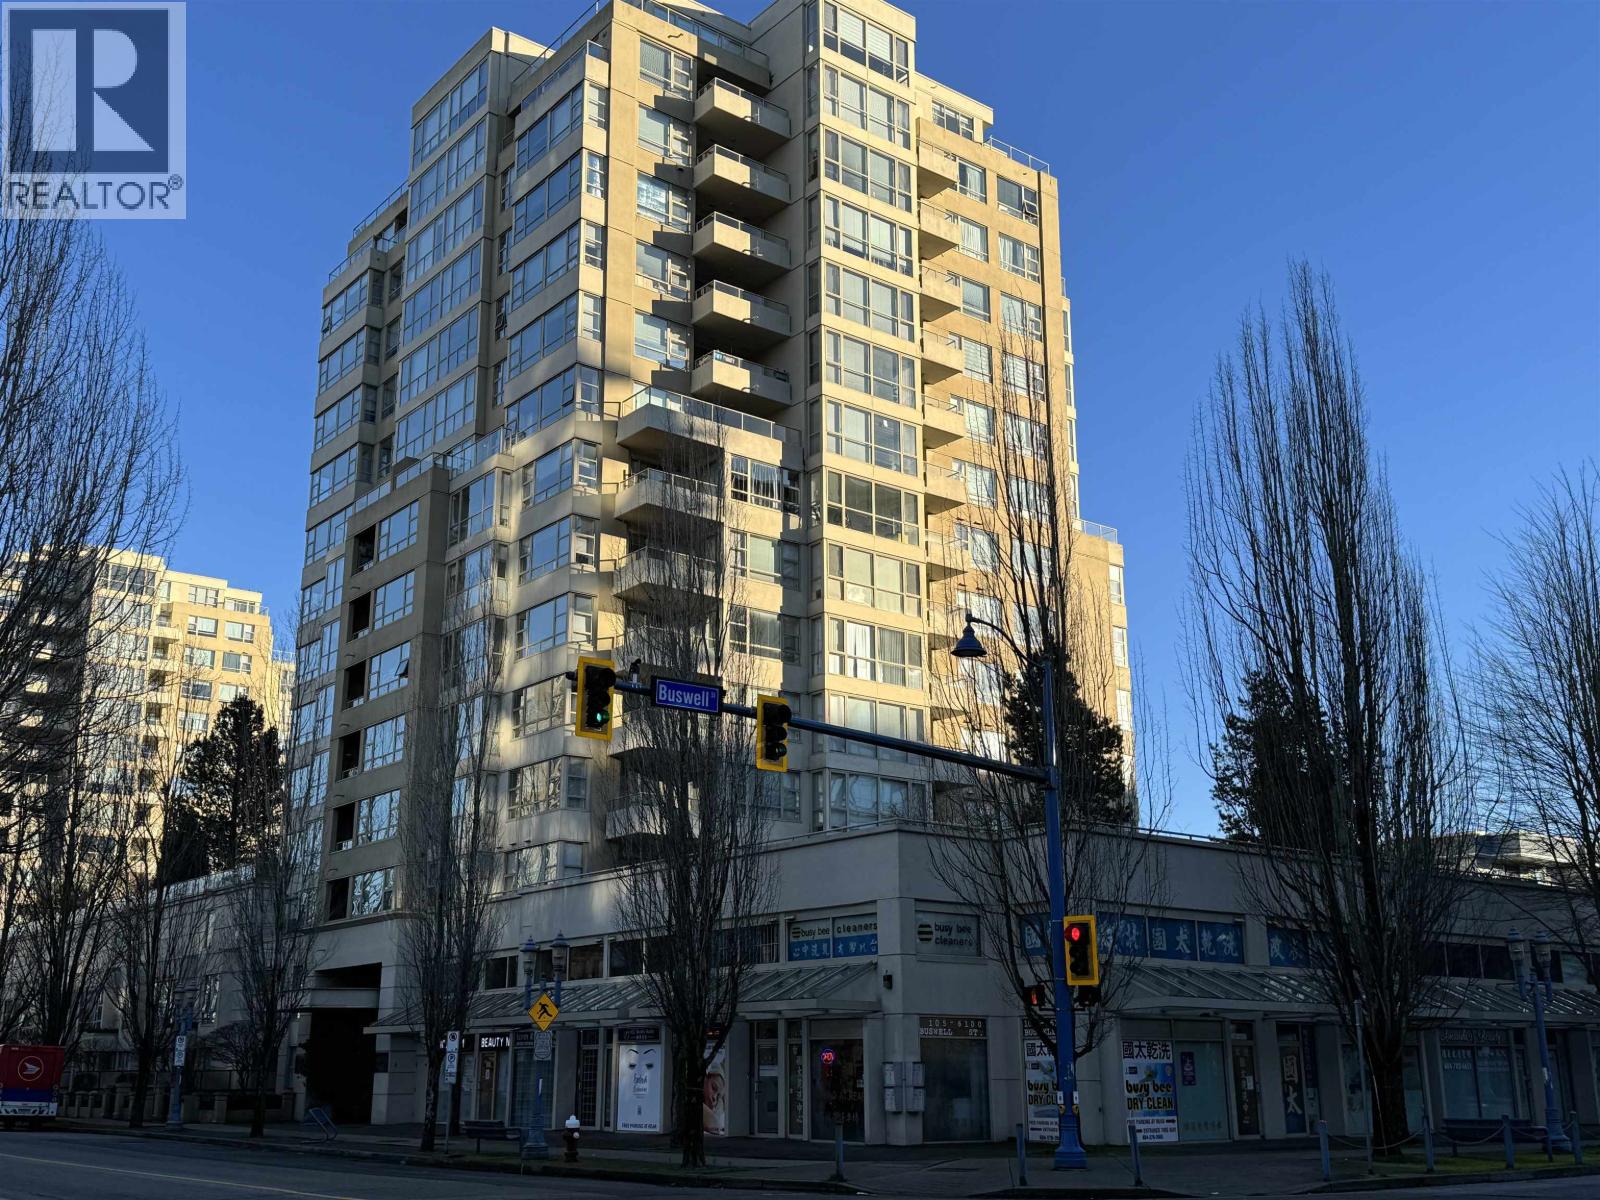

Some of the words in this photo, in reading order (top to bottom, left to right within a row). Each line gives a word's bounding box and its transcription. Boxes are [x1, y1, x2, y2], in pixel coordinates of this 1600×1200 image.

[658, 683, 710, 707] Buswell
[801, 927, 816, 940] busy
[817, 925, 830, 936] bee
[836, 922, 878, 935] cleaners
[934, 922, 953, 936] busy
[935, 936, 973, 946] cleaners
[919, 1027, 953, 1037] BUSWELL
[481, 1036, 504, 1049] BEAUTY
[1122, 1041, 1171, 1060] 國太乾洗
[1126, 1079, 1150, 1097] busy
[1152, 1079, 1171, 1093] bee
[1028, 1094, 1043, 1105] DRY
[1127, 1097, 1144, 1111] DRY
[1146, 1097, 1174, 1111] CLEAN
